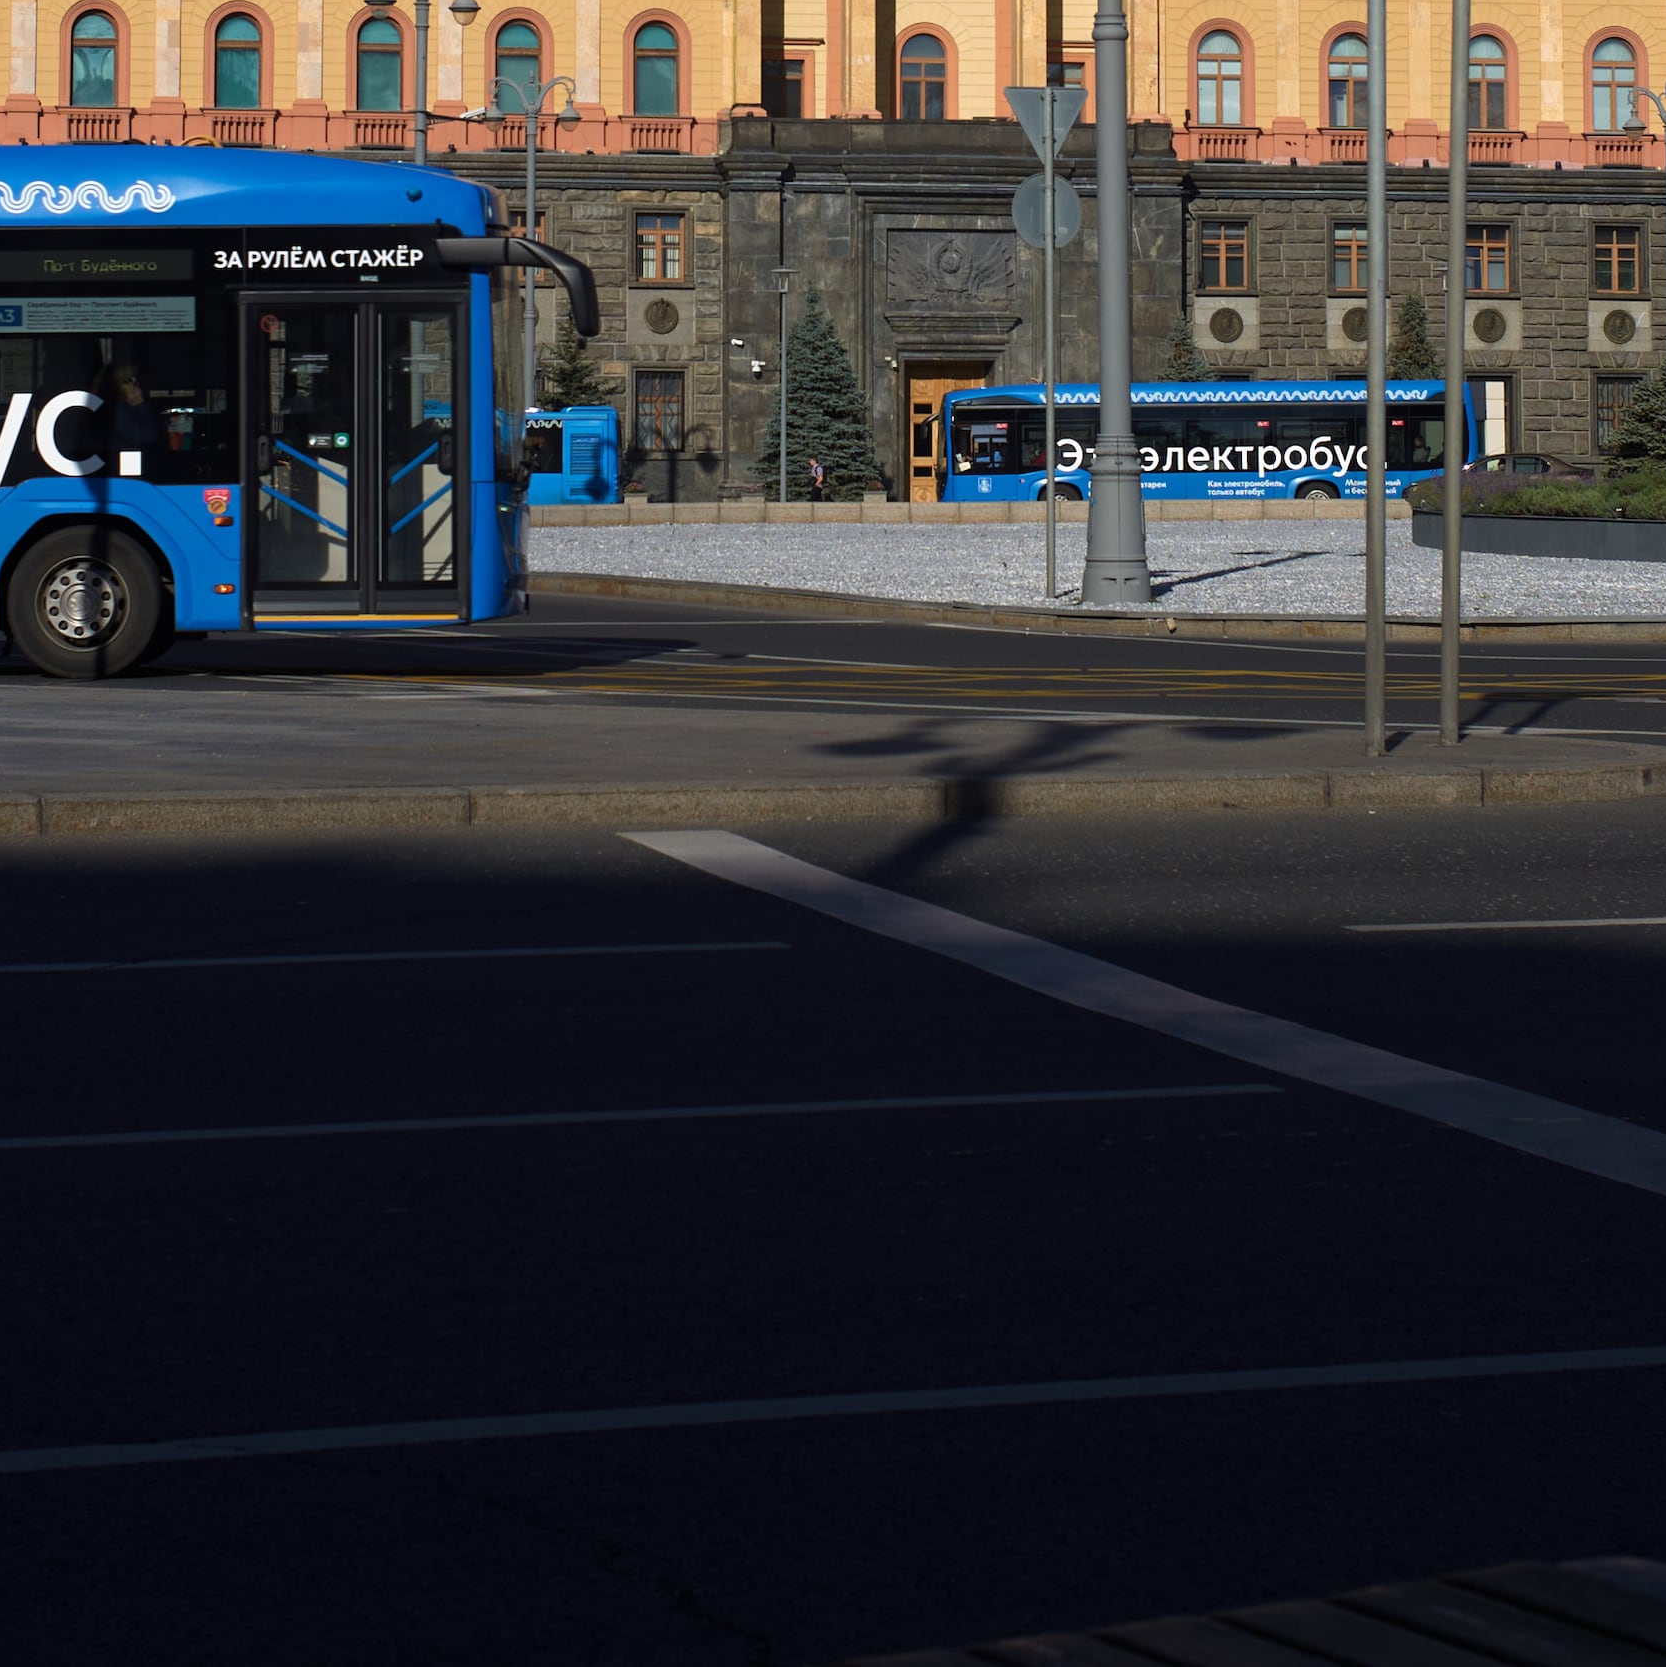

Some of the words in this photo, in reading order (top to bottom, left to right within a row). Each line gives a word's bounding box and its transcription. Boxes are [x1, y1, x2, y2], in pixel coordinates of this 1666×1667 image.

[213, 250, 243, 269] ЗА
[247, 246, 327, 269] РУЛЁМ
[330, 245, 424, 268] СТАЖЁР
[81, 259, 158, 273] Будённого
[1207, 480, 1222, 488] Как
[1235, 488, 1266, 496] автобус
